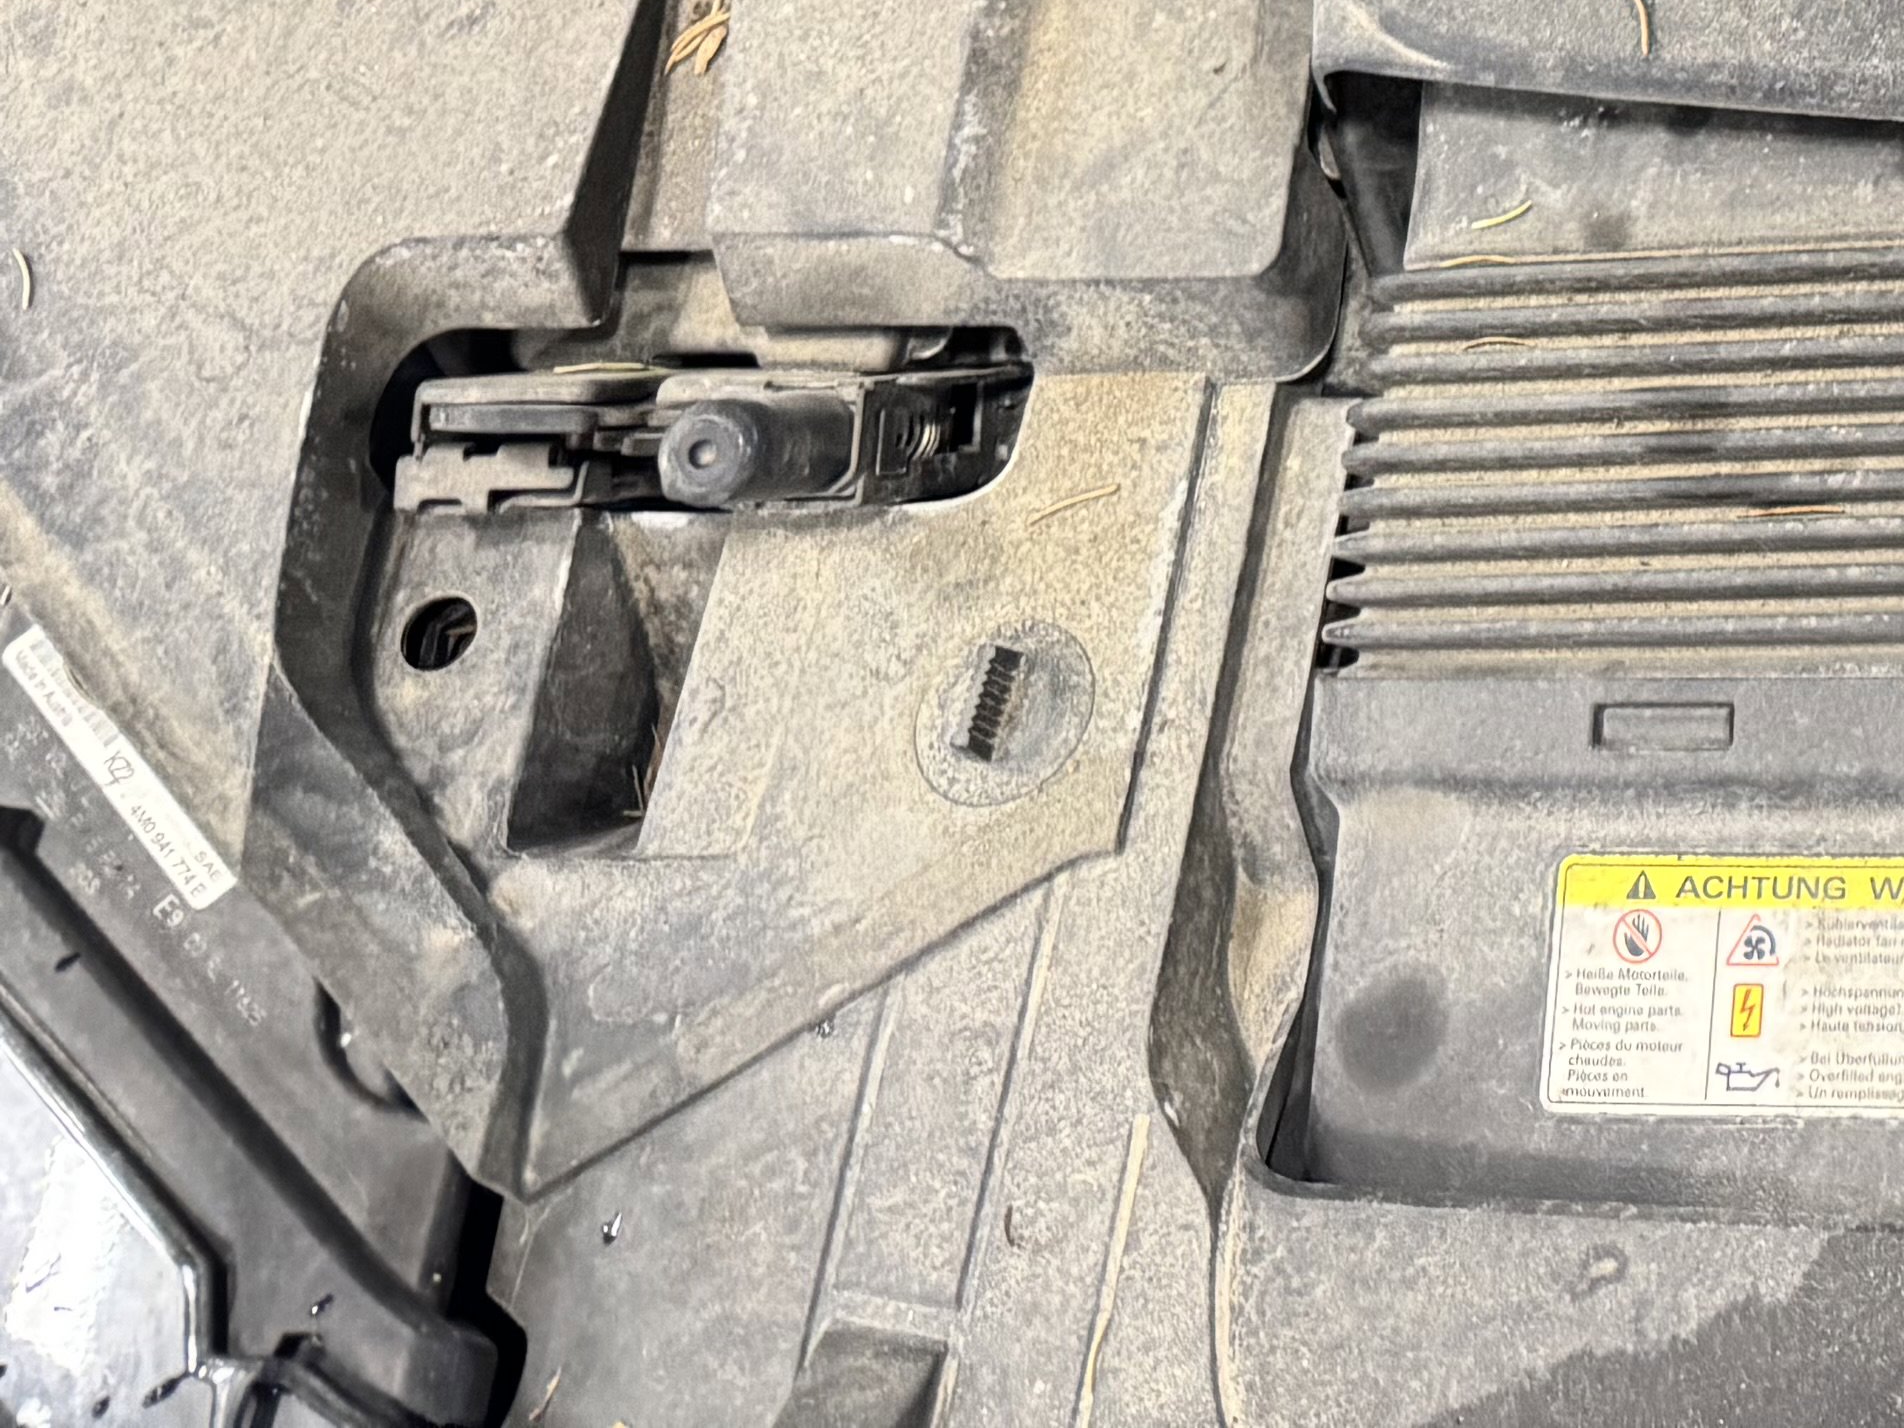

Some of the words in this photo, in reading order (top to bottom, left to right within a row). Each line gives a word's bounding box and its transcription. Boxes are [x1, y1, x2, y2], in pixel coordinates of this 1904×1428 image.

[1676, 876, 1847, 901] ACHTUNG
[1615, 1038, 1632, 1052] du
[1809, 1068, 1874, 1082] Overfilled
